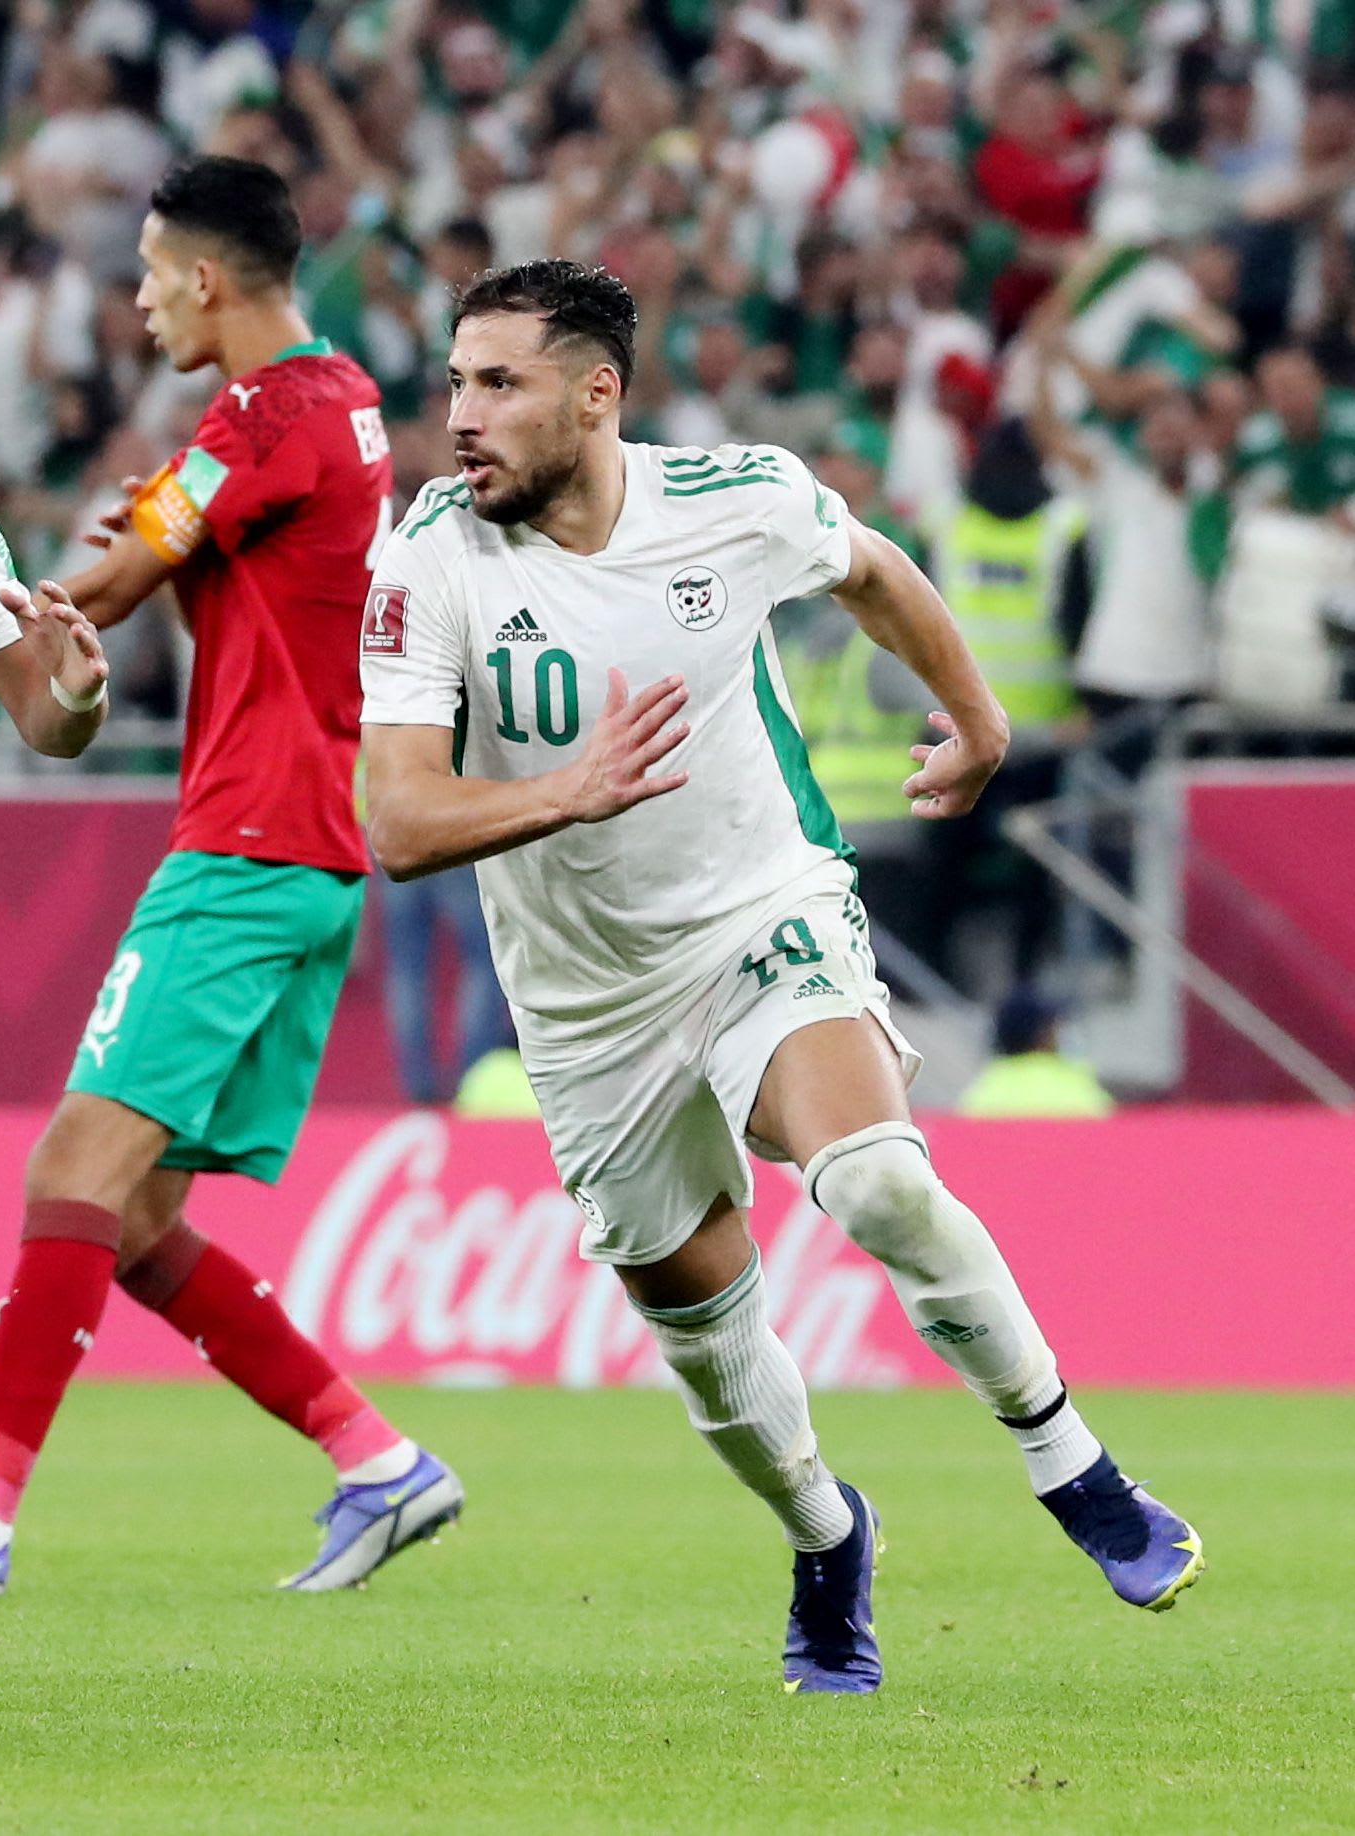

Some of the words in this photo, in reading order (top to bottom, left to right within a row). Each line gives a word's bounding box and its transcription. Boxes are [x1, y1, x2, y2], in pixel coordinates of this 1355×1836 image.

[495, 629, 548, 642] adidas
[486, 647, 580, 747] 10
[737, 917, 824, 990] 10
[793, 986, 844, 1000] adidas
